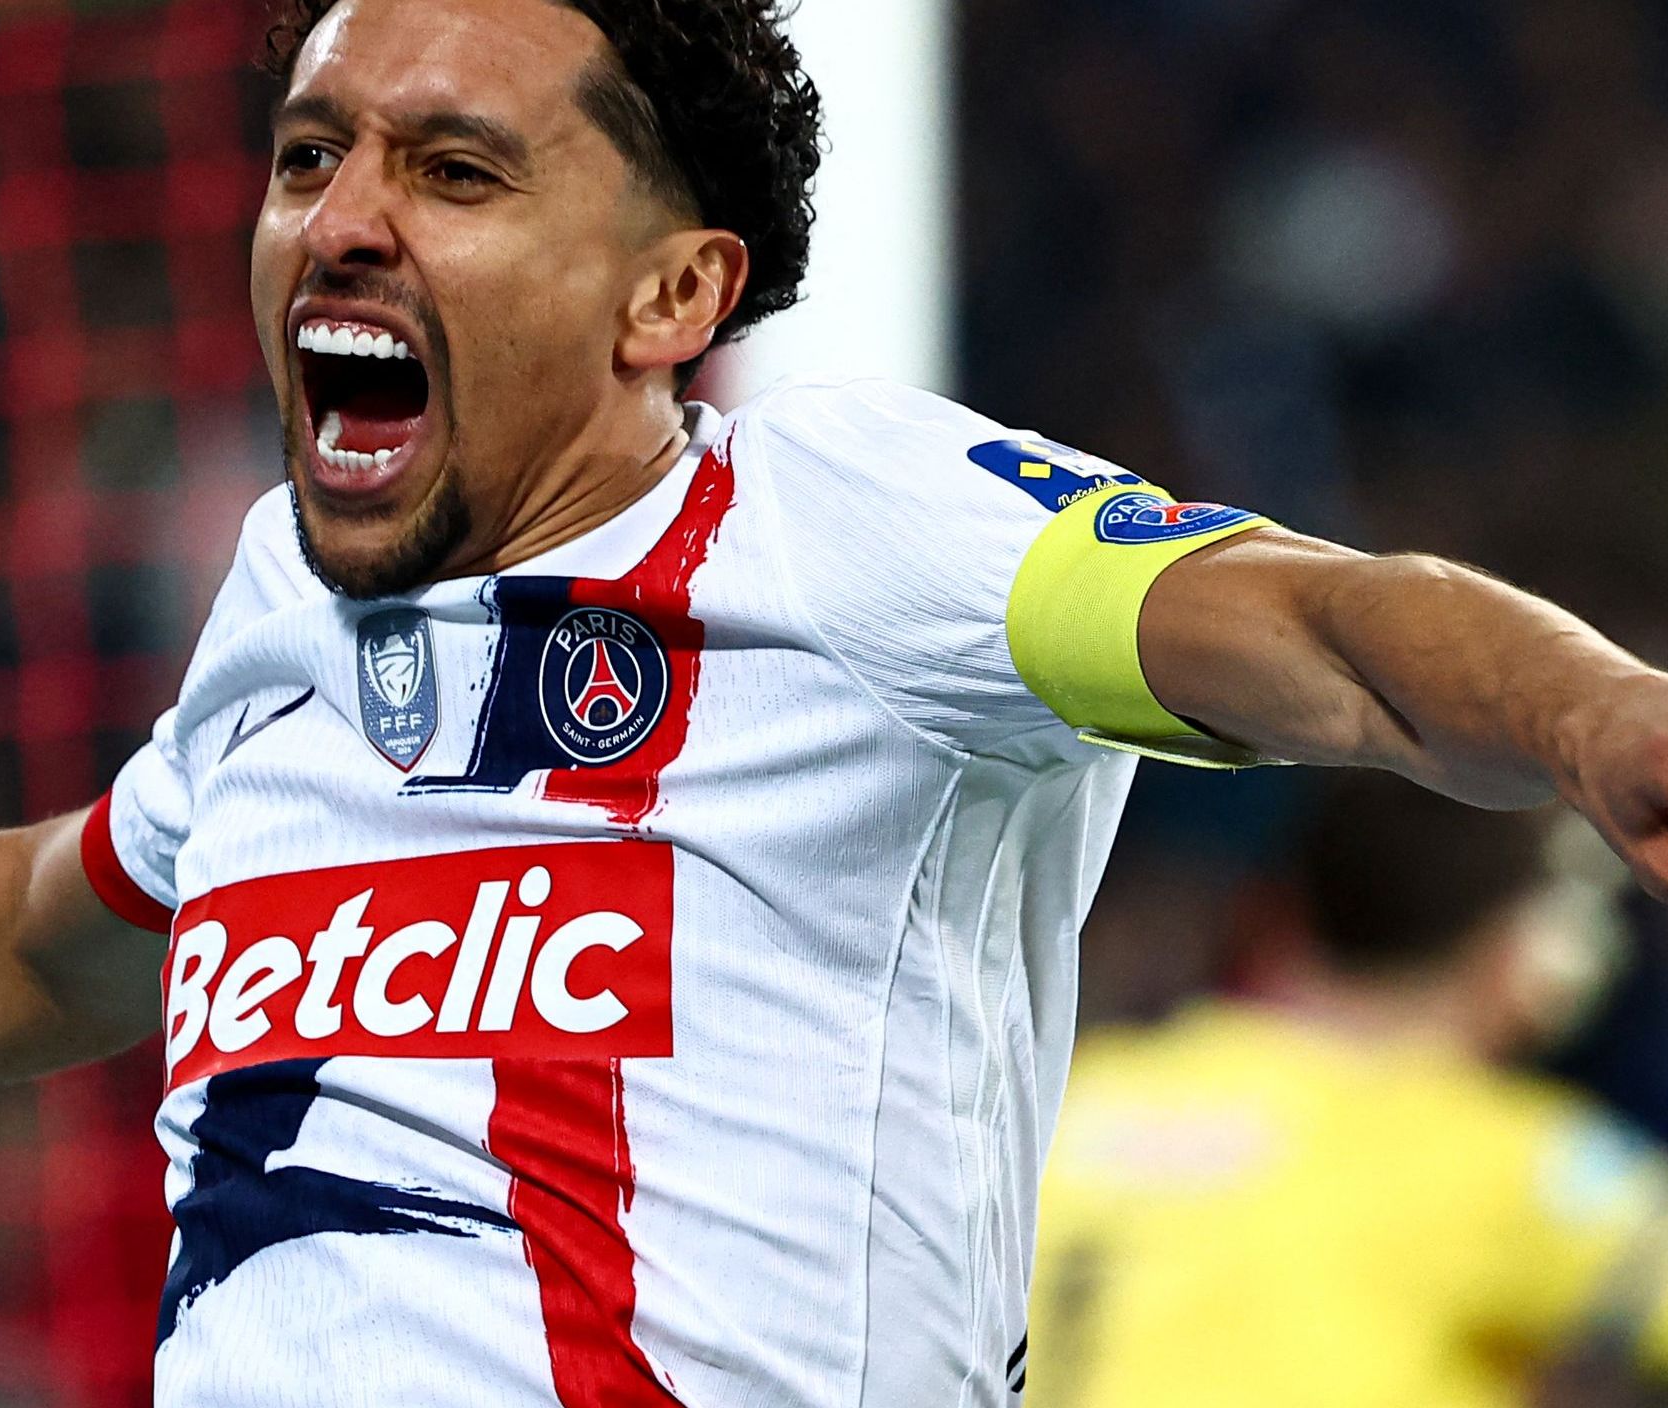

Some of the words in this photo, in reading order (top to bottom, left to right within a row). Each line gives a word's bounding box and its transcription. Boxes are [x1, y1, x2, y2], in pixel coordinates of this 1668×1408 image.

[556, 614, 637, 652] PARIS
[380, 713, 422, 734] FFF
[165, 866, 644, 1088] Betclic
